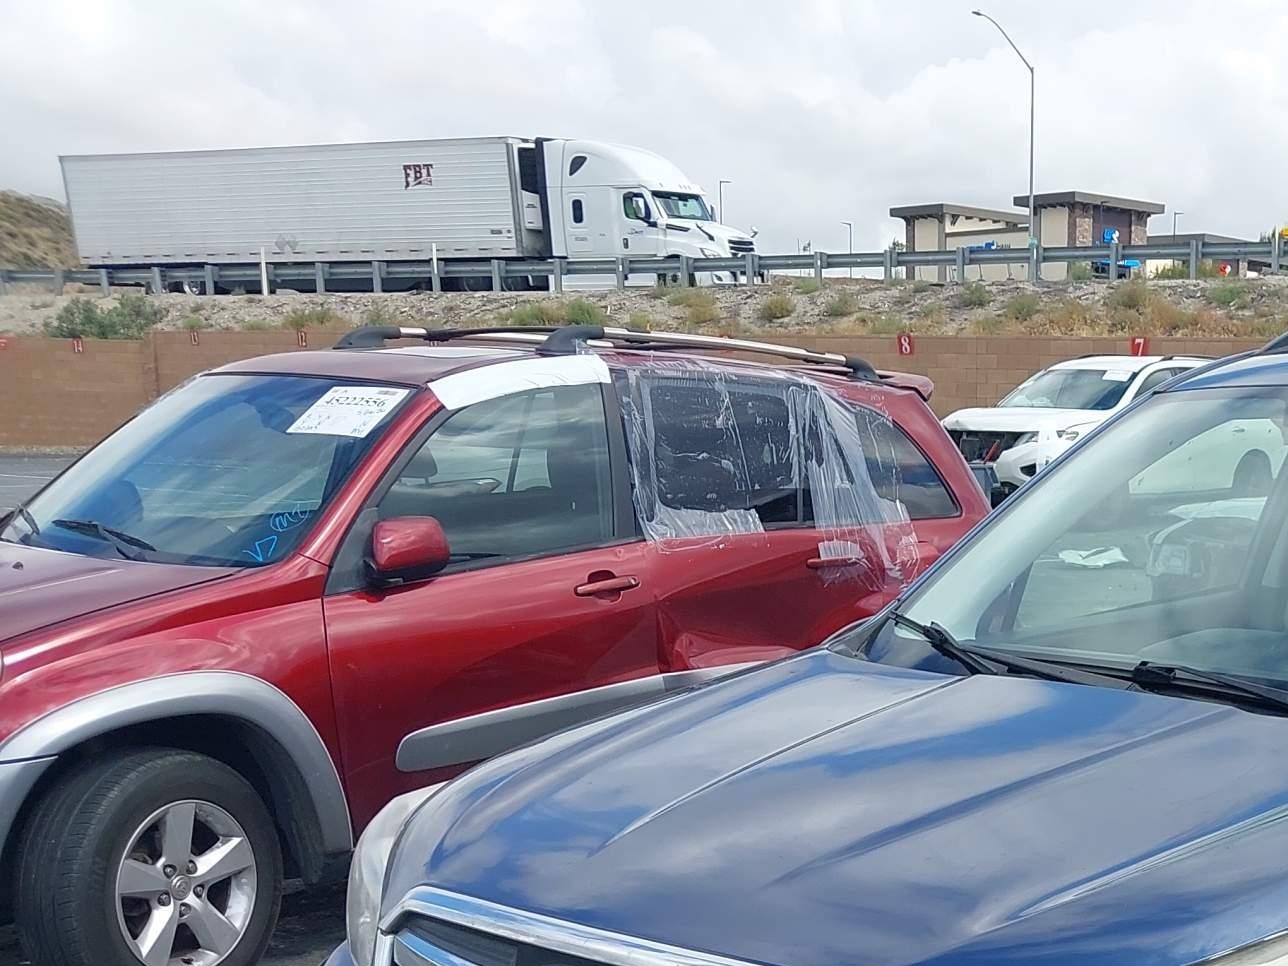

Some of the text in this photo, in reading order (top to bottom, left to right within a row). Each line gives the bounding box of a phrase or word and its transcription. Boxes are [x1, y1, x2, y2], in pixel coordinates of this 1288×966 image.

[403, 164, 433, 190] FBT
[901, 336, 910, 354] 8
[1135, 338, 1144, 356] 7
